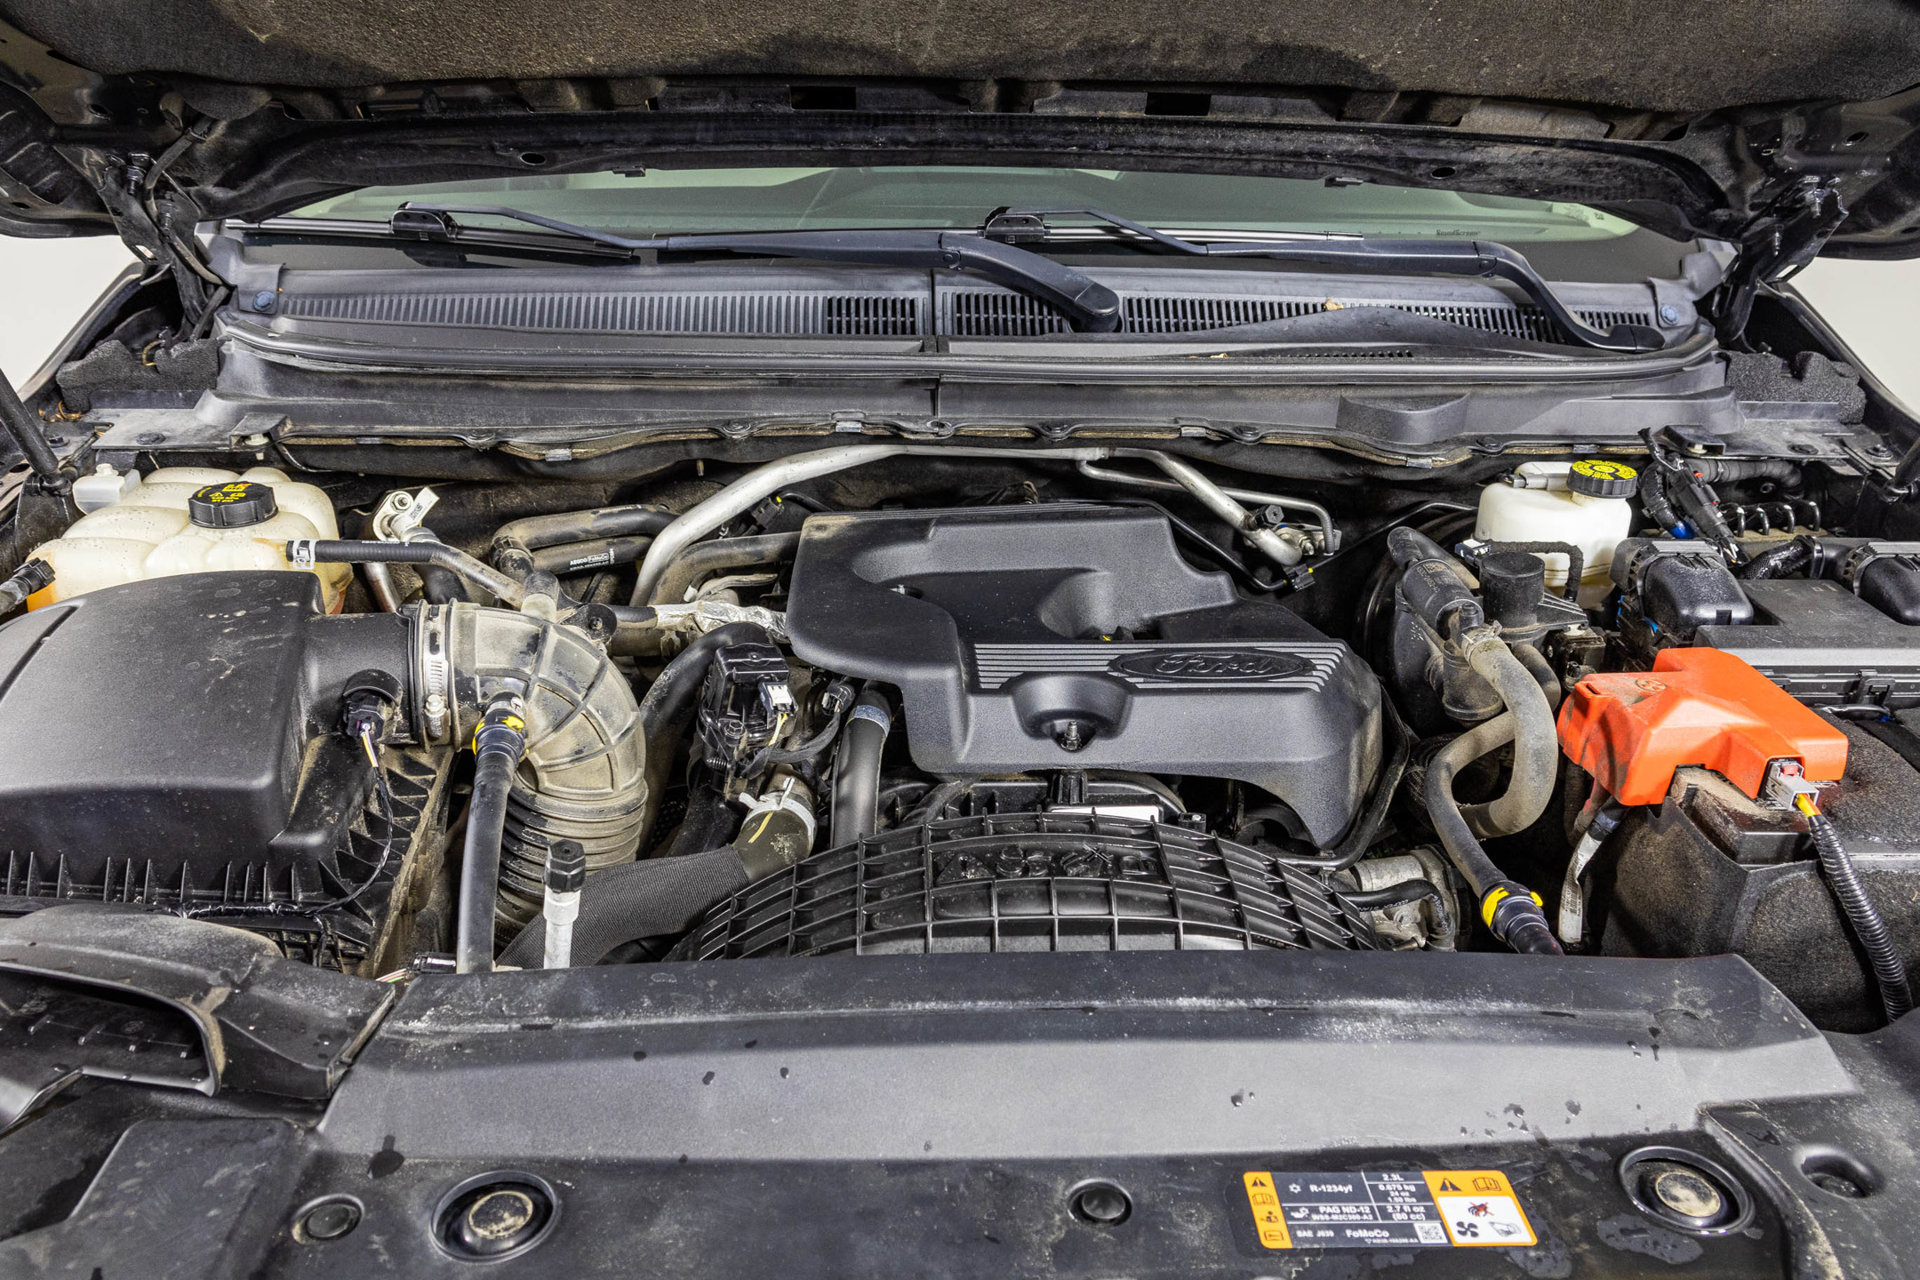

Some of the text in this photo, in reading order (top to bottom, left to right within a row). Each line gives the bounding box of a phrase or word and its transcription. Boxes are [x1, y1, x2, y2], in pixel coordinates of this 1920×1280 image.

[1155, 653, 1273, 674] Ford
[1382, 1173, 1404, 1181] 2.3L
[1309, 1184, 1353, 1194] R-1234yf
[1345, 1229, 1390, 1238] FoMoCo
